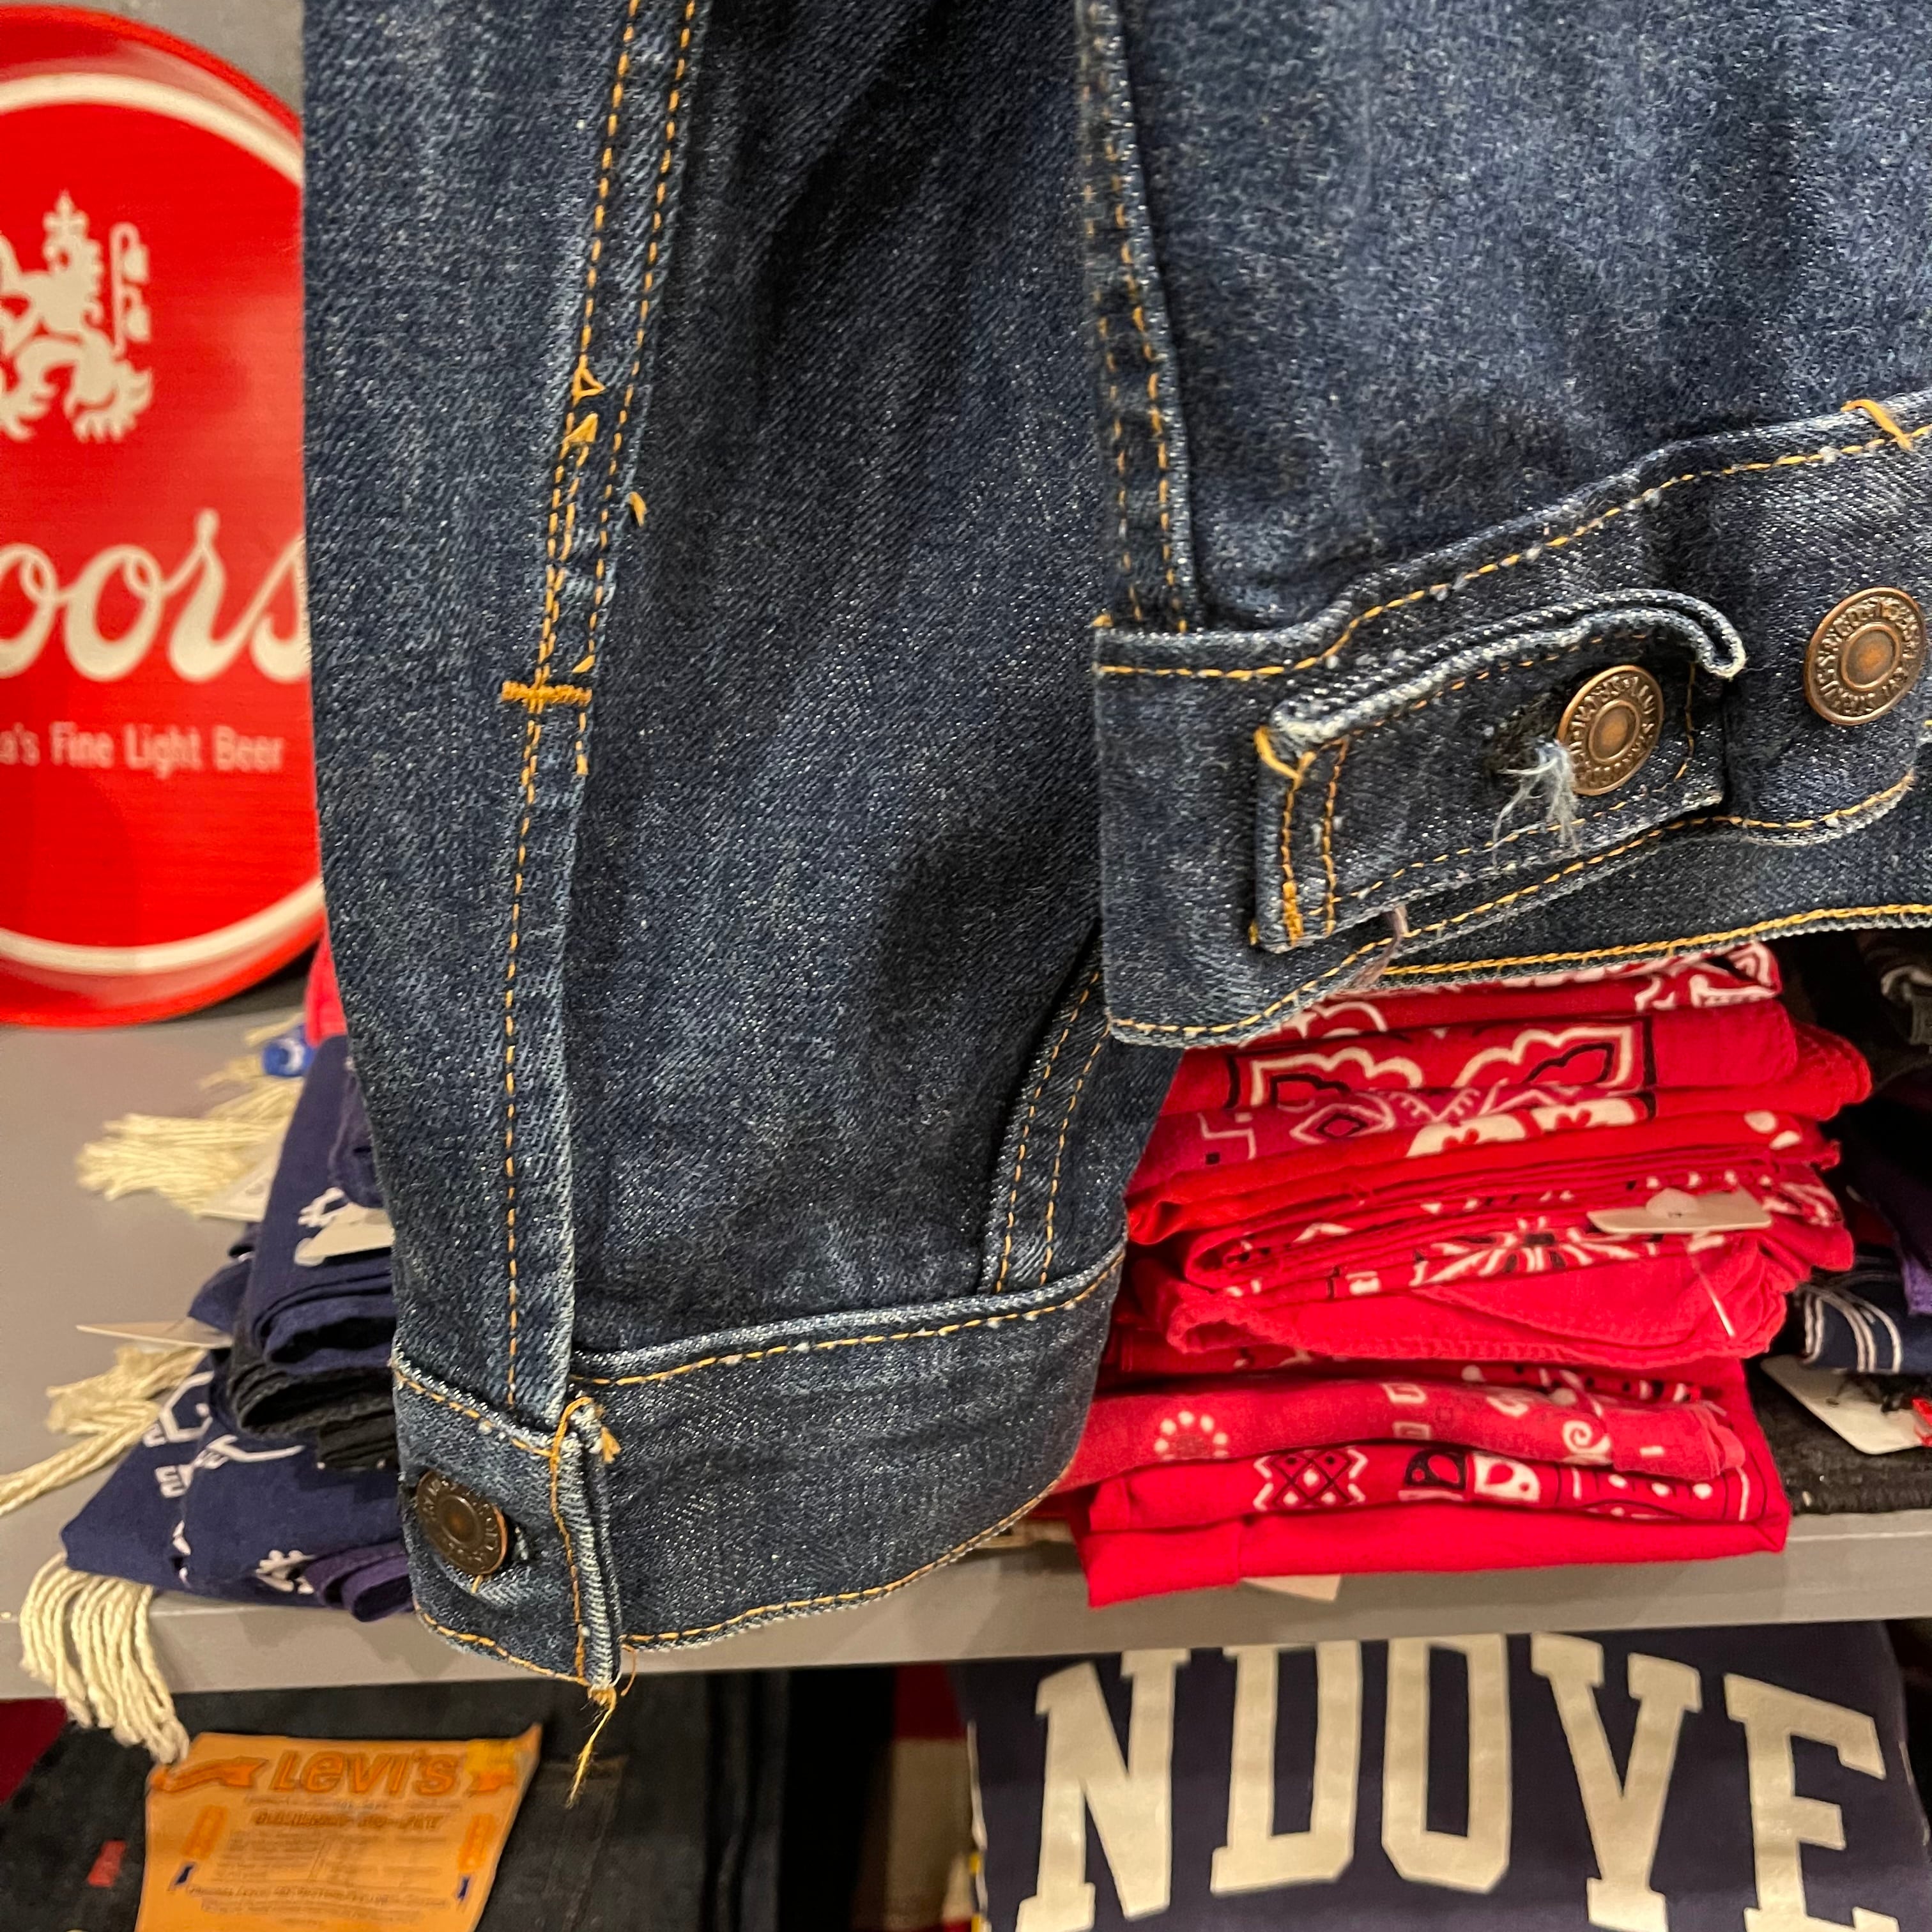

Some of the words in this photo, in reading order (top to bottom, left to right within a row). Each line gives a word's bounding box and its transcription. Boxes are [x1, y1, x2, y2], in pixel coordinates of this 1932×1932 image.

[49, 721, 114, 769] Fine
[123, 723, 201, 779] Light
[213, 725, 283, 772] Beer
[1016, 1632, 1899, 1932] NDOVE
